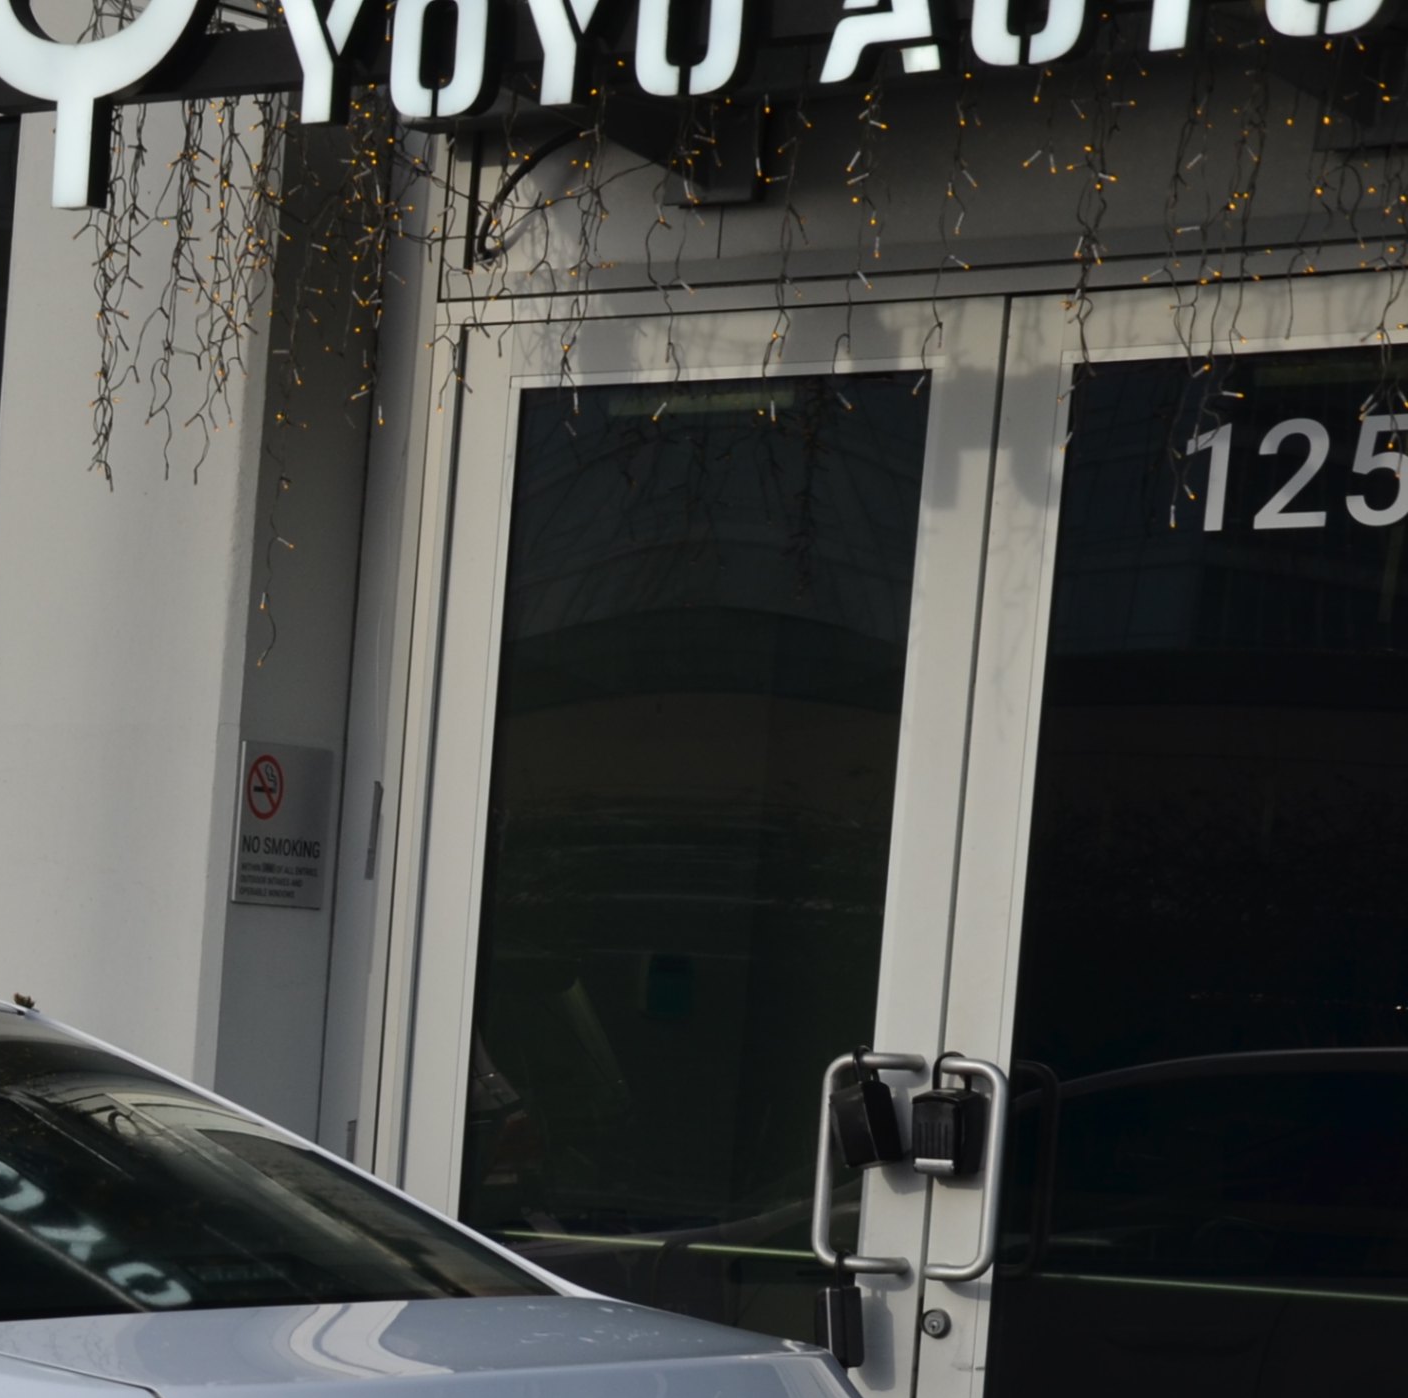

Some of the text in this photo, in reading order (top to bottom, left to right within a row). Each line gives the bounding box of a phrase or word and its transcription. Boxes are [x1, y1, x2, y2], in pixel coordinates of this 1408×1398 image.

[287, 0, 1387, 123] YOYO AU
[1186, 416, 1408, 532] 125
[241, 834, 321, 859] NO SMOKING
